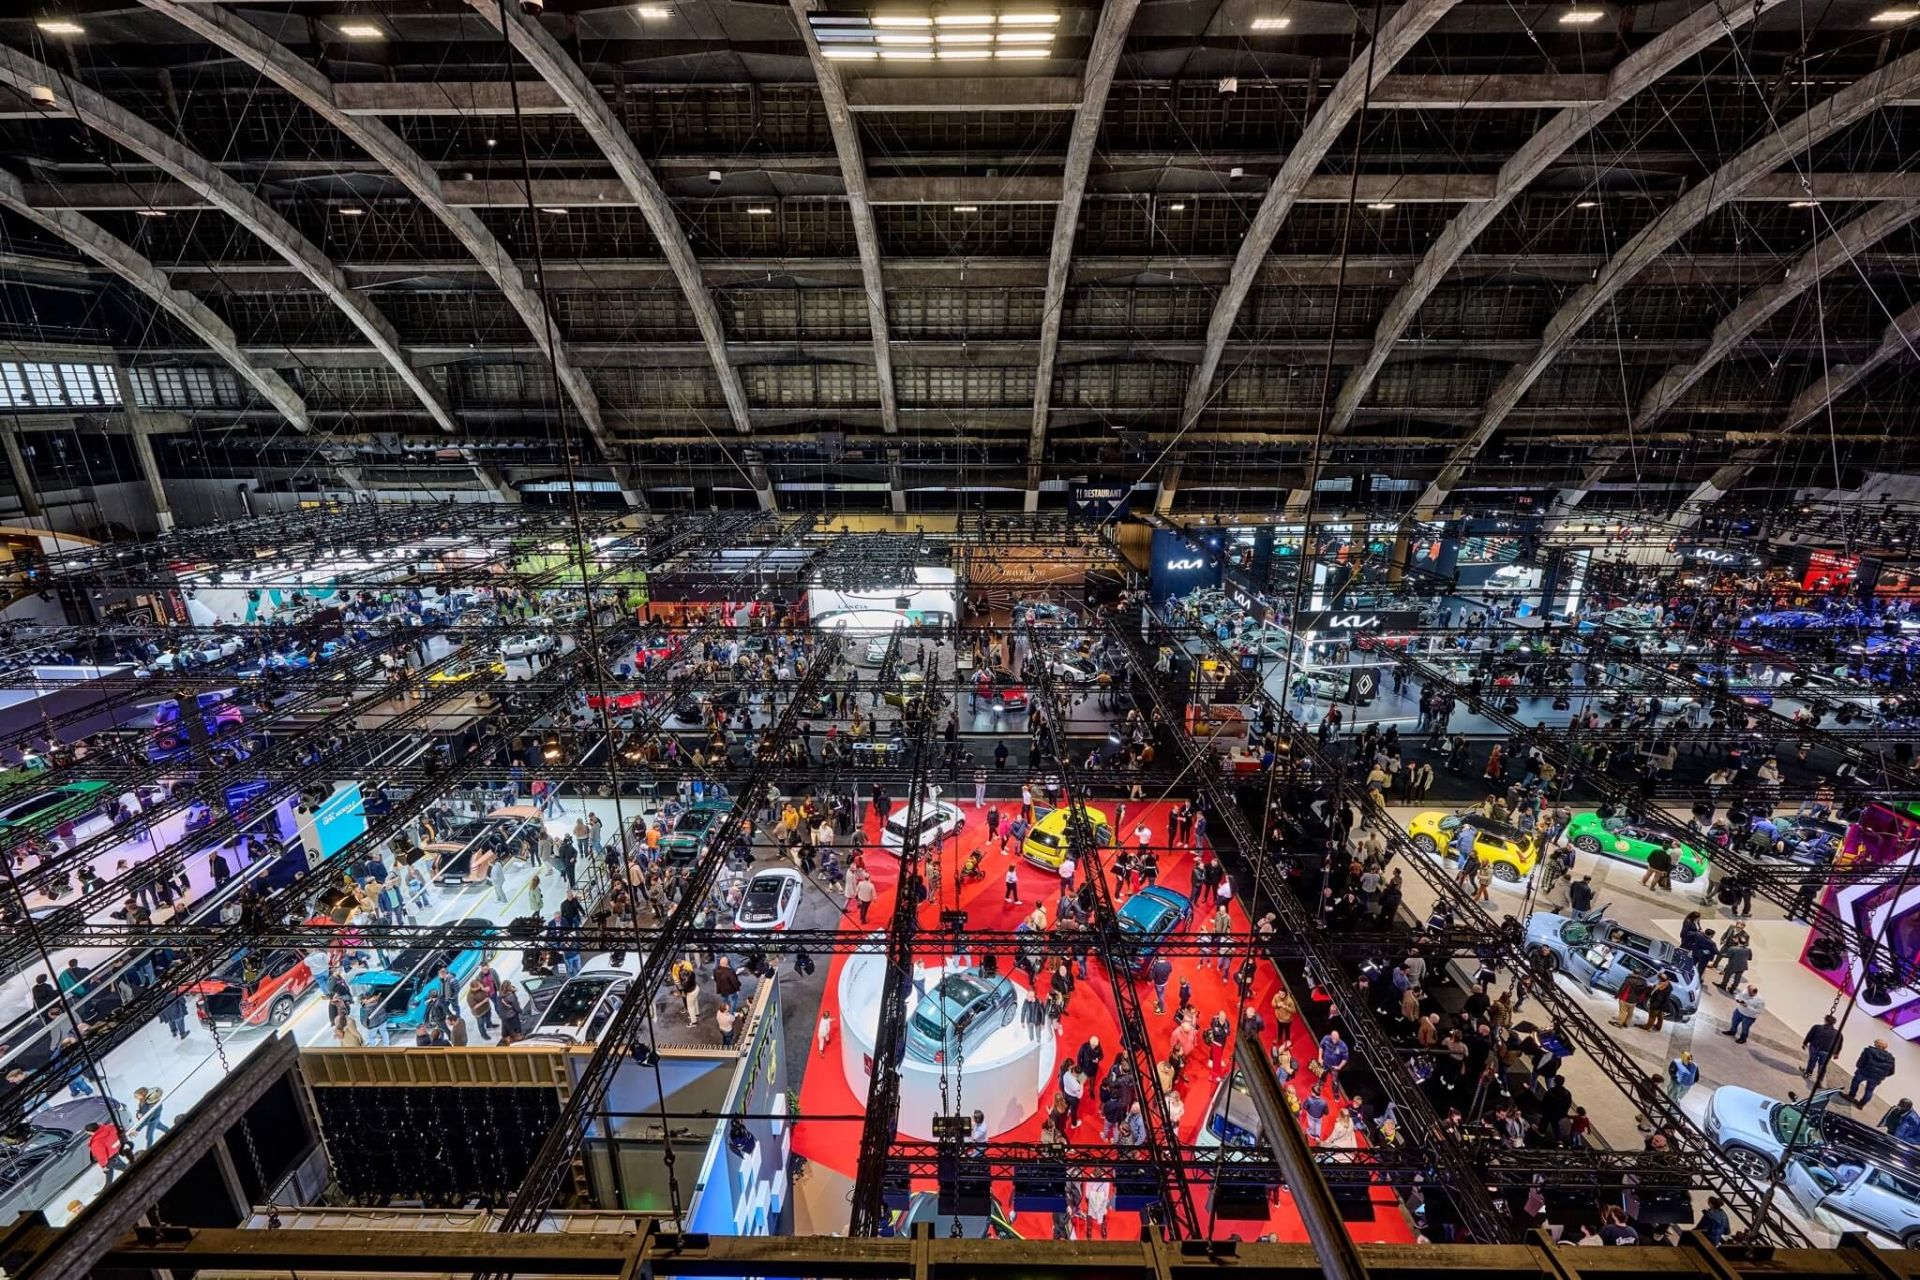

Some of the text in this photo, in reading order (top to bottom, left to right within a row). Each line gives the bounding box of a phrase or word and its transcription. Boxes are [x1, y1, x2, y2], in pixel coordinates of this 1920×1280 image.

[1084, 489, 1121, 498] RESTAURANT
[1167, 559, 1203, 570] KIA
[1234, 590, 1251, 610] KIA
[1330, 614, 1380, 627] KIA
